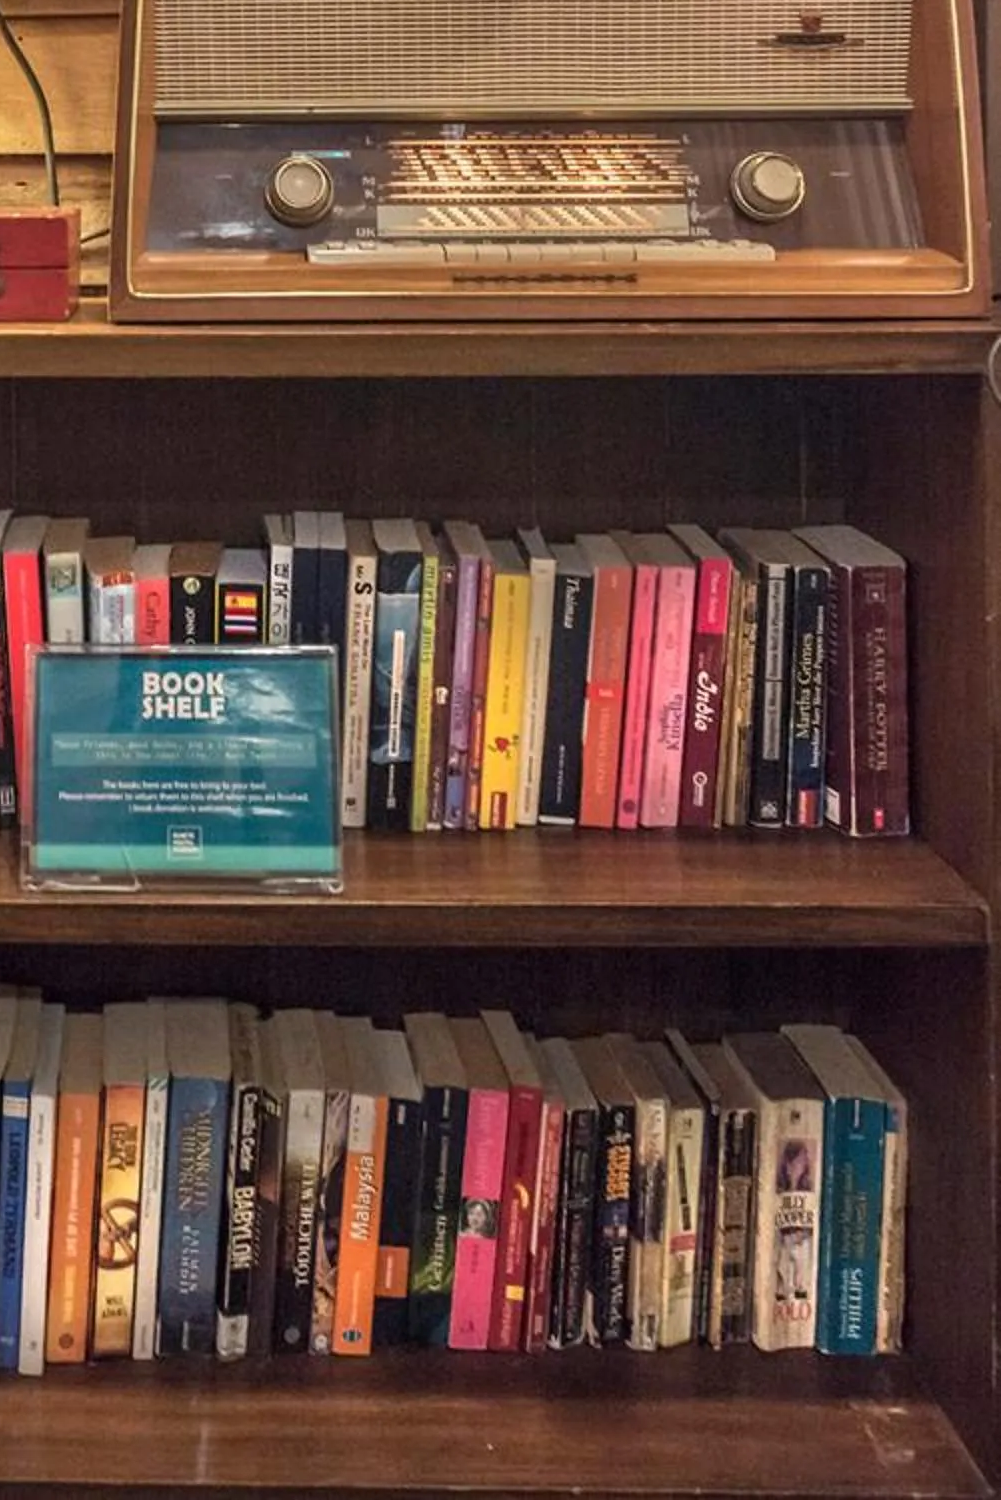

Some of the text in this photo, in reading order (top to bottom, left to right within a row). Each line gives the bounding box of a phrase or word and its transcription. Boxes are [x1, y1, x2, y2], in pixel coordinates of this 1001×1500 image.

[144, 590, 162, 640] Cathy
[354, 582, 373, 595] S
[422, 565, 435, 622] martin
[184, 606, 197, 634] JOHN
[351, 602, 362, 647] FRANK
[421, 627, 434, 665] amis
[142, 696, 226, 719] SHELF
[143, 672, 225, 695] BOOK
[349, 651, 360, 707] SINATRA
[796, 633, 814, 740] Martha Grimes
[874, 628, 888, 772] HARRY POTTER
[666, 694, 684, 751] Kinsella
[107, 1122, 127, 1171] LEGACY
[615, 1144, 631, 1201] STUART
[349, 1155, 378, 1240] Malaysia
[231, 1185, 255, 1269] BABYLON
[294, 1204, 313, 1287] TÖDLICHE
[608, 1246, 624, 1324] Dirty Work
[846, 1268, 863, 1339] PHILLIPS
